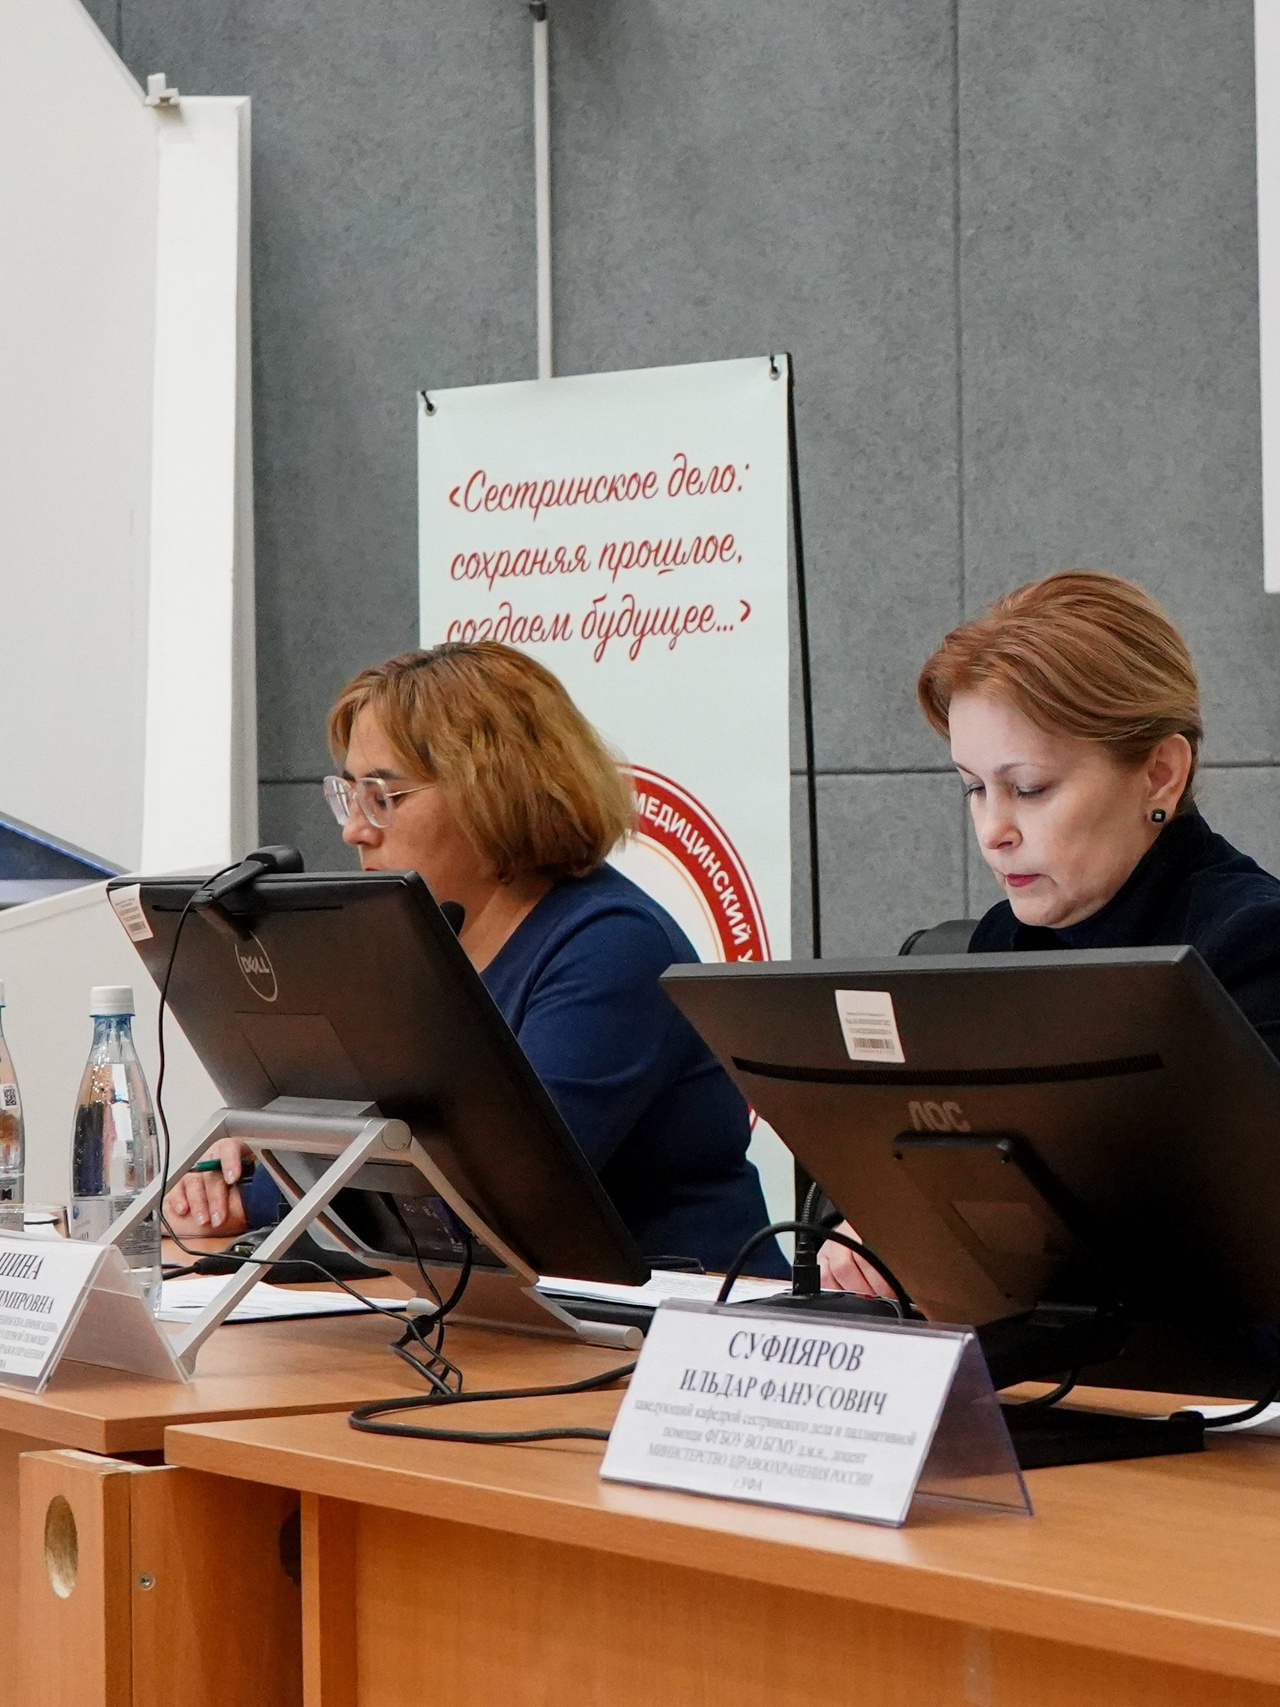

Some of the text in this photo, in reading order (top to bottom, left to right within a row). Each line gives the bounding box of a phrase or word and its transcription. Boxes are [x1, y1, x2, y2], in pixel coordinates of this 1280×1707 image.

[667, 452, 751, 497] дело:
[450, 544, 591, 592] сохраняя
[633, 790, 752, 946] МЕДИЦИНСКИЙ
[240, 956, 270, 974] DELL
[728, 1330, 865, 1372] СУФИЯРОВ
[679, 1368, 888, 1415] ИЛЬДАР ФАНУСОВИЧ
[695, 1406, 741, 1425] кафедрой
[705, 1429, 743, 1446] ФГБОУ
[744, 1433, 762, 1449] ВО
[762, 1436, 797, 1454] БГМУ
